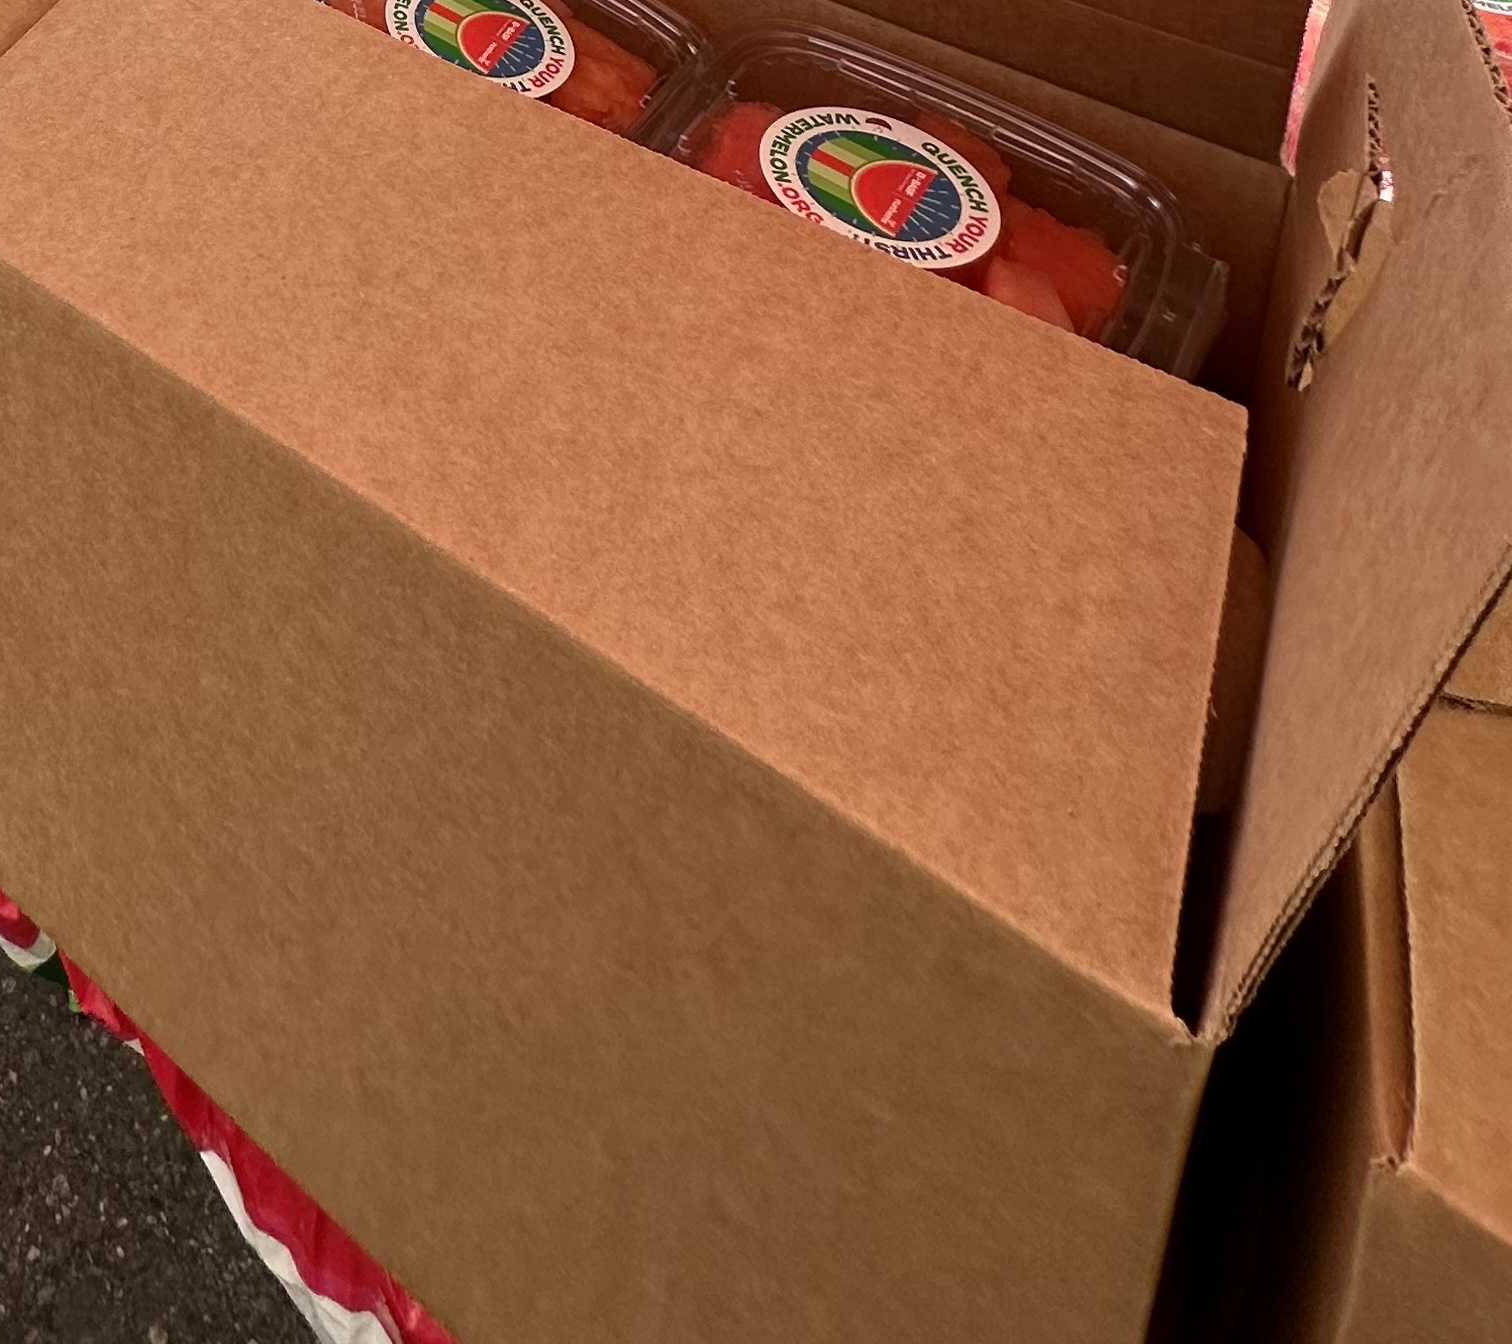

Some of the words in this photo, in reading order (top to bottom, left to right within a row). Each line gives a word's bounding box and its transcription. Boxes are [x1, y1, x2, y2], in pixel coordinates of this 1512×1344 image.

[528, 56, 565, 89] YOUR
[769, 112, 861, 225] WATERMELON.ORG
[921, 141, 989, 213] QUENCH
[945, 215, 989, 254] YOUR
